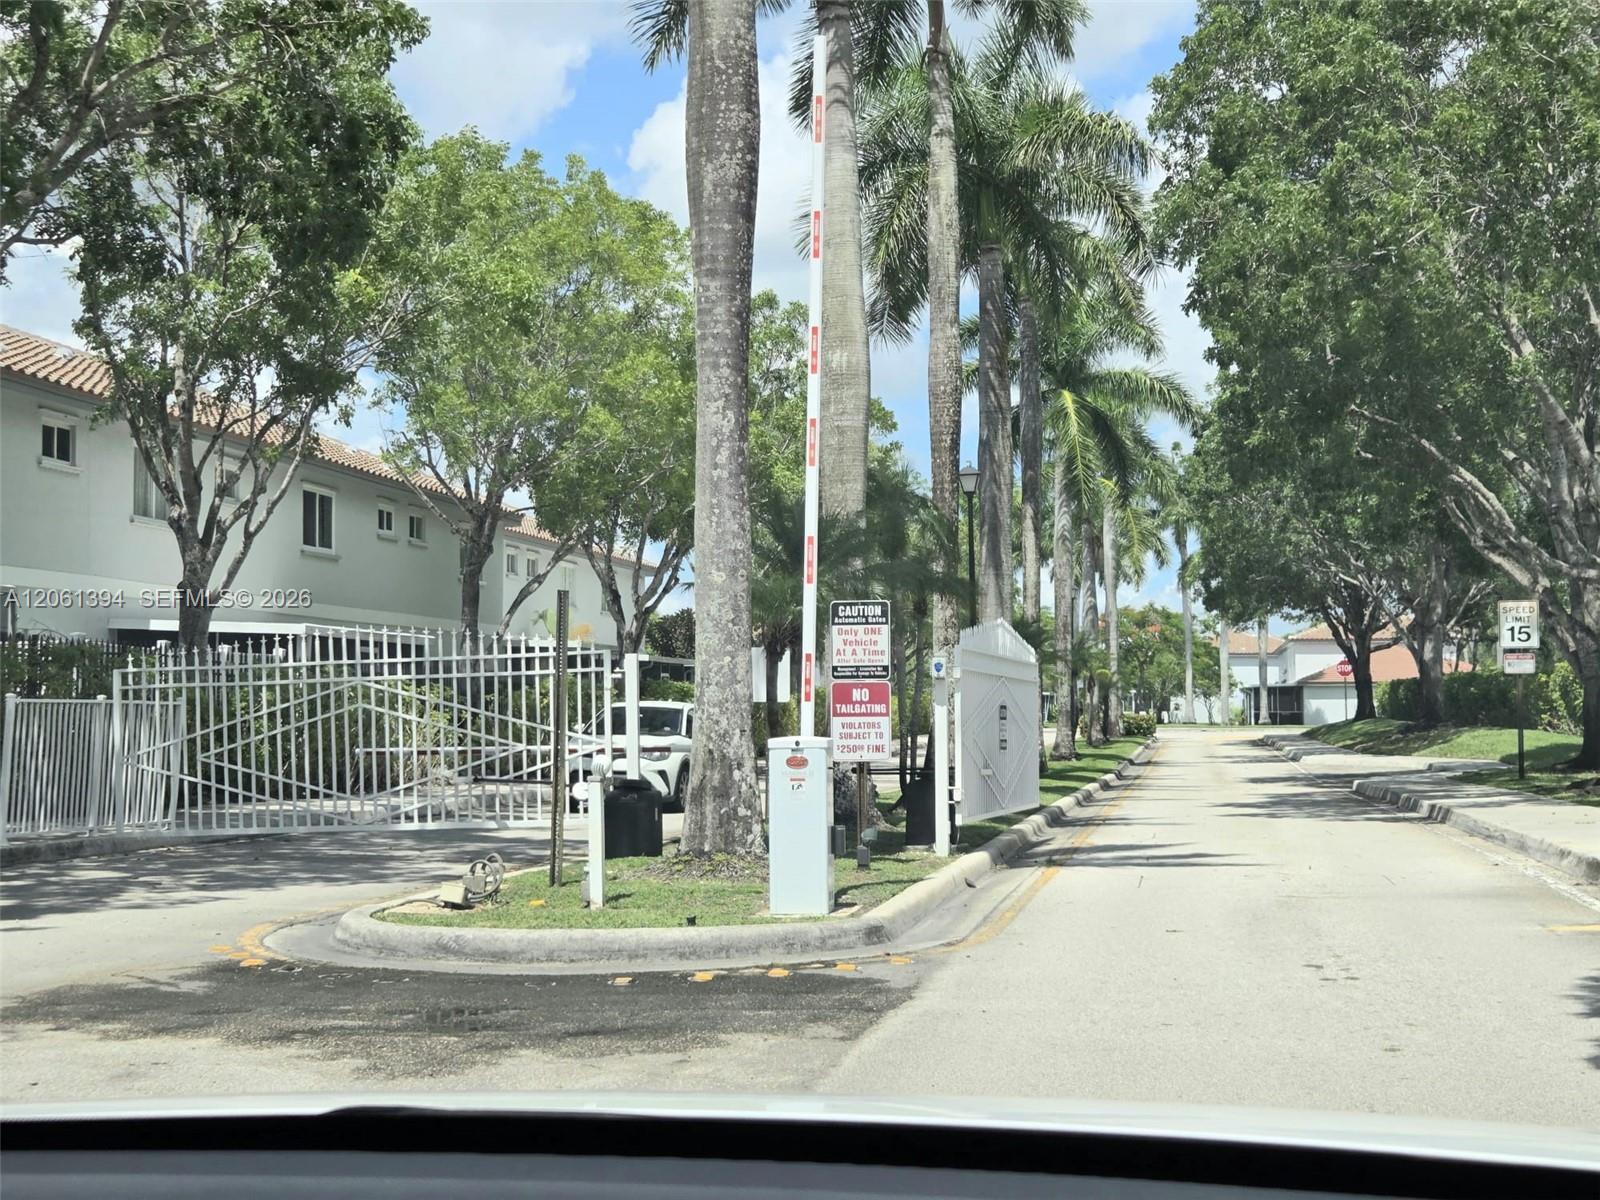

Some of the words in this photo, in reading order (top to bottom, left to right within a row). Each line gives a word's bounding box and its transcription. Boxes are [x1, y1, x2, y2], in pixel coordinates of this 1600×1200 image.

[838, 605, 882, 617] CAUTION
[1502, 606, 1535, 614] SPEED
[1505, 616, 1531, 624] LIMIT
[837, 628, 859, 637] Only
[1505, 625, 1531, 642] 15
[852, 688, 870, 701] NO
[835, 704, 887, 713] TAILGATING
[841, 722, 882, 730] VIOLATORS
[839, 732, 871, 740] SUBJECT
[875, 732, 884, 740] TO
[867, 745, 886, 753] FINE
